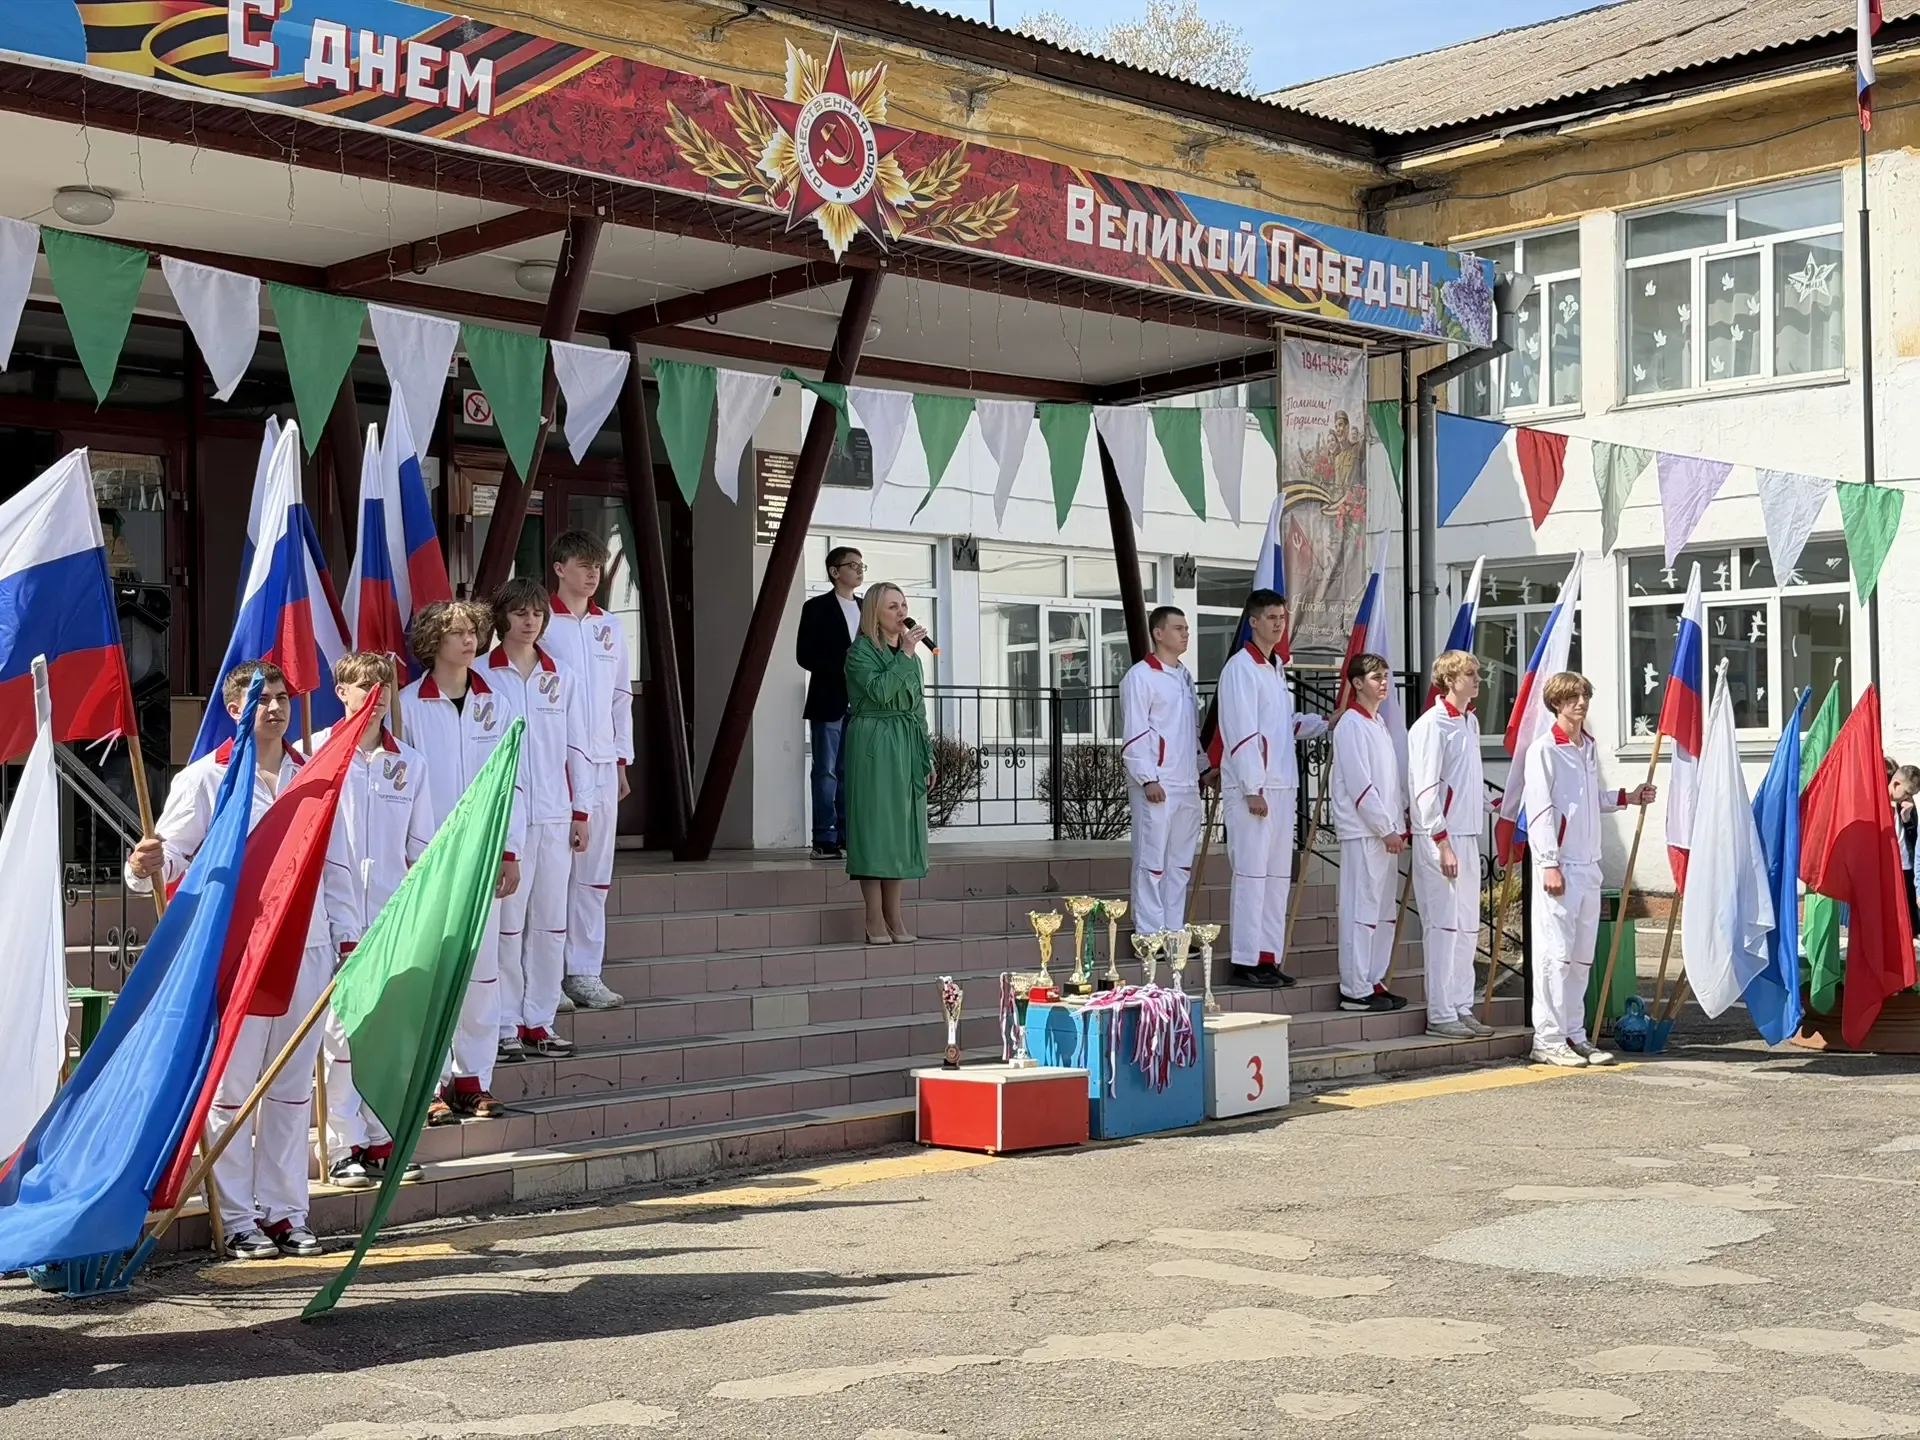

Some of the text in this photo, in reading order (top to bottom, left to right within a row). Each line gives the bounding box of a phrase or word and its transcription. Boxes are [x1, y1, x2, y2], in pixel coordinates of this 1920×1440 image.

[228, 0, 279, 70] С
[304, 17, 496, 118] ДНЕМ
[798, 97, 869, 189] ОТЕЧЕСТВЕННАЯ
[1302, 351, 1349, 376] 1941-1945
[1246, 1055, 1264, 1101] 3
